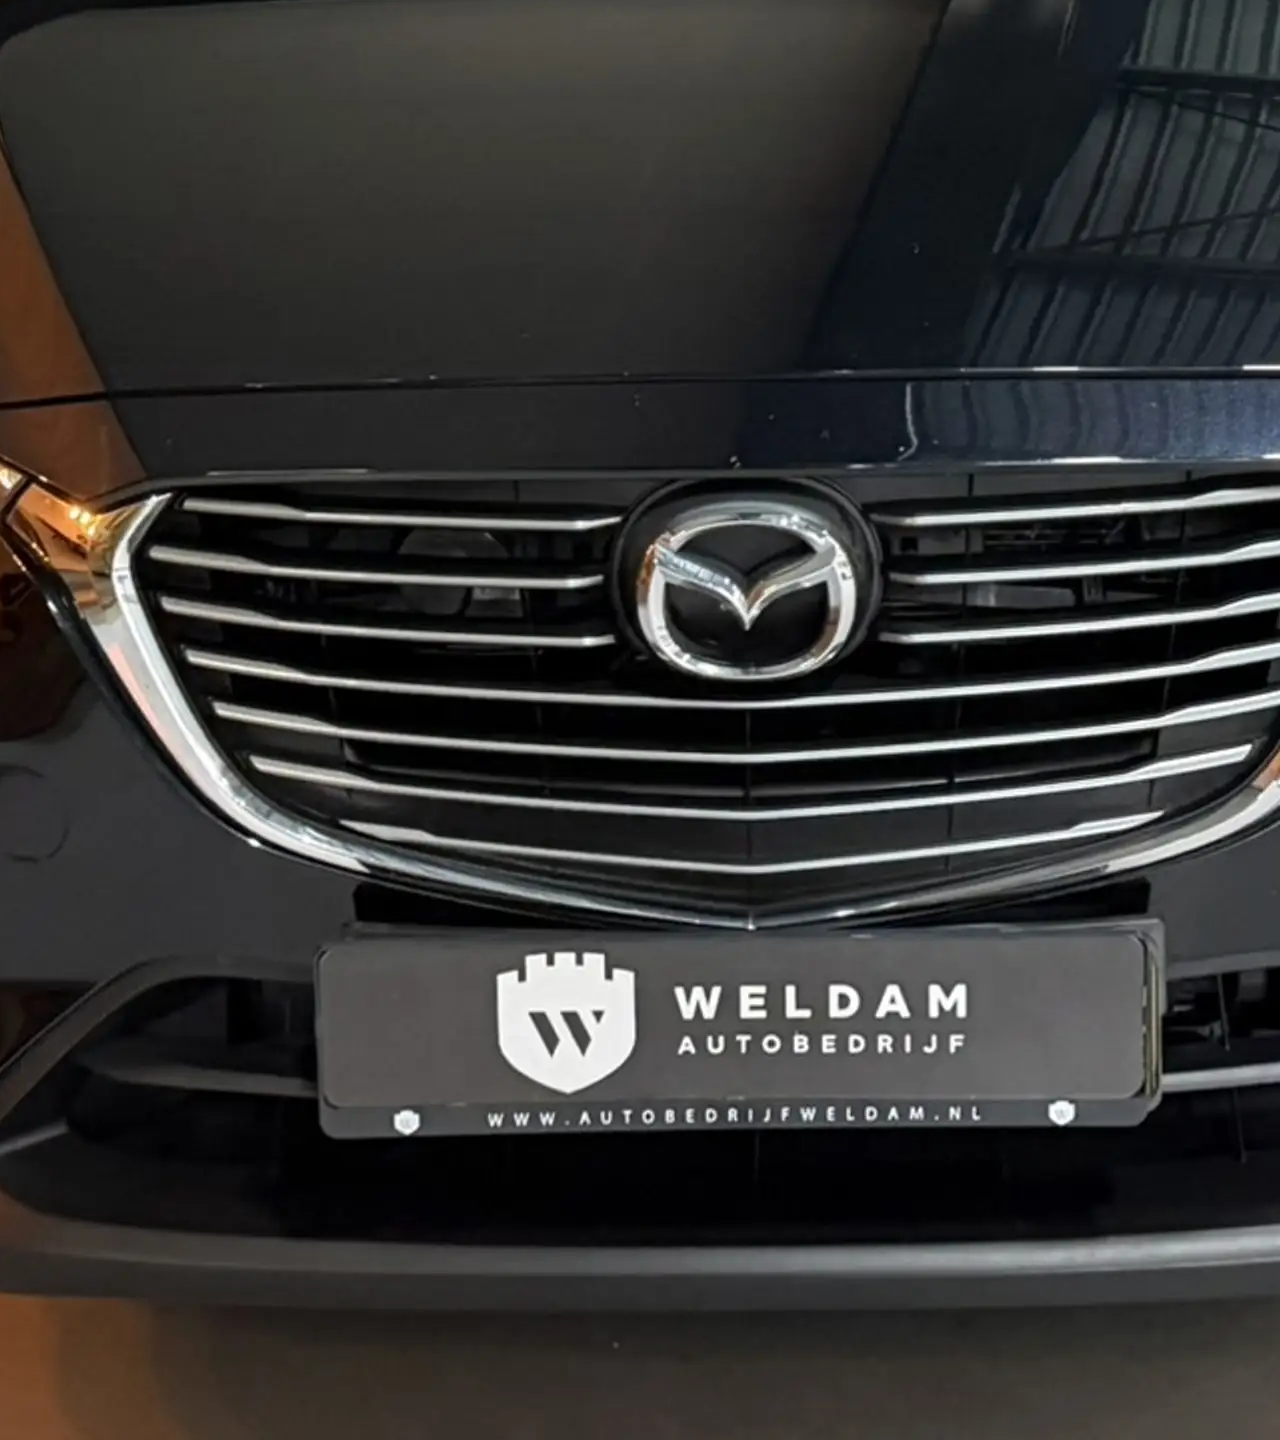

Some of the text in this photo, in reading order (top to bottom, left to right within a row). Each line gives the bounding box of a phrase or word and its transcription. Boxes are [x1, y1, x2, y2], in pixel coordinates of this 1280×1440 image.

[674, 984, 968, 1020] WELDAM
[677, 1033, 965, 1055] AUTOBEDRIJF
[487, 1106, 981, 1127] WWW.AUTOBEDRIJFWELDAM.NL
